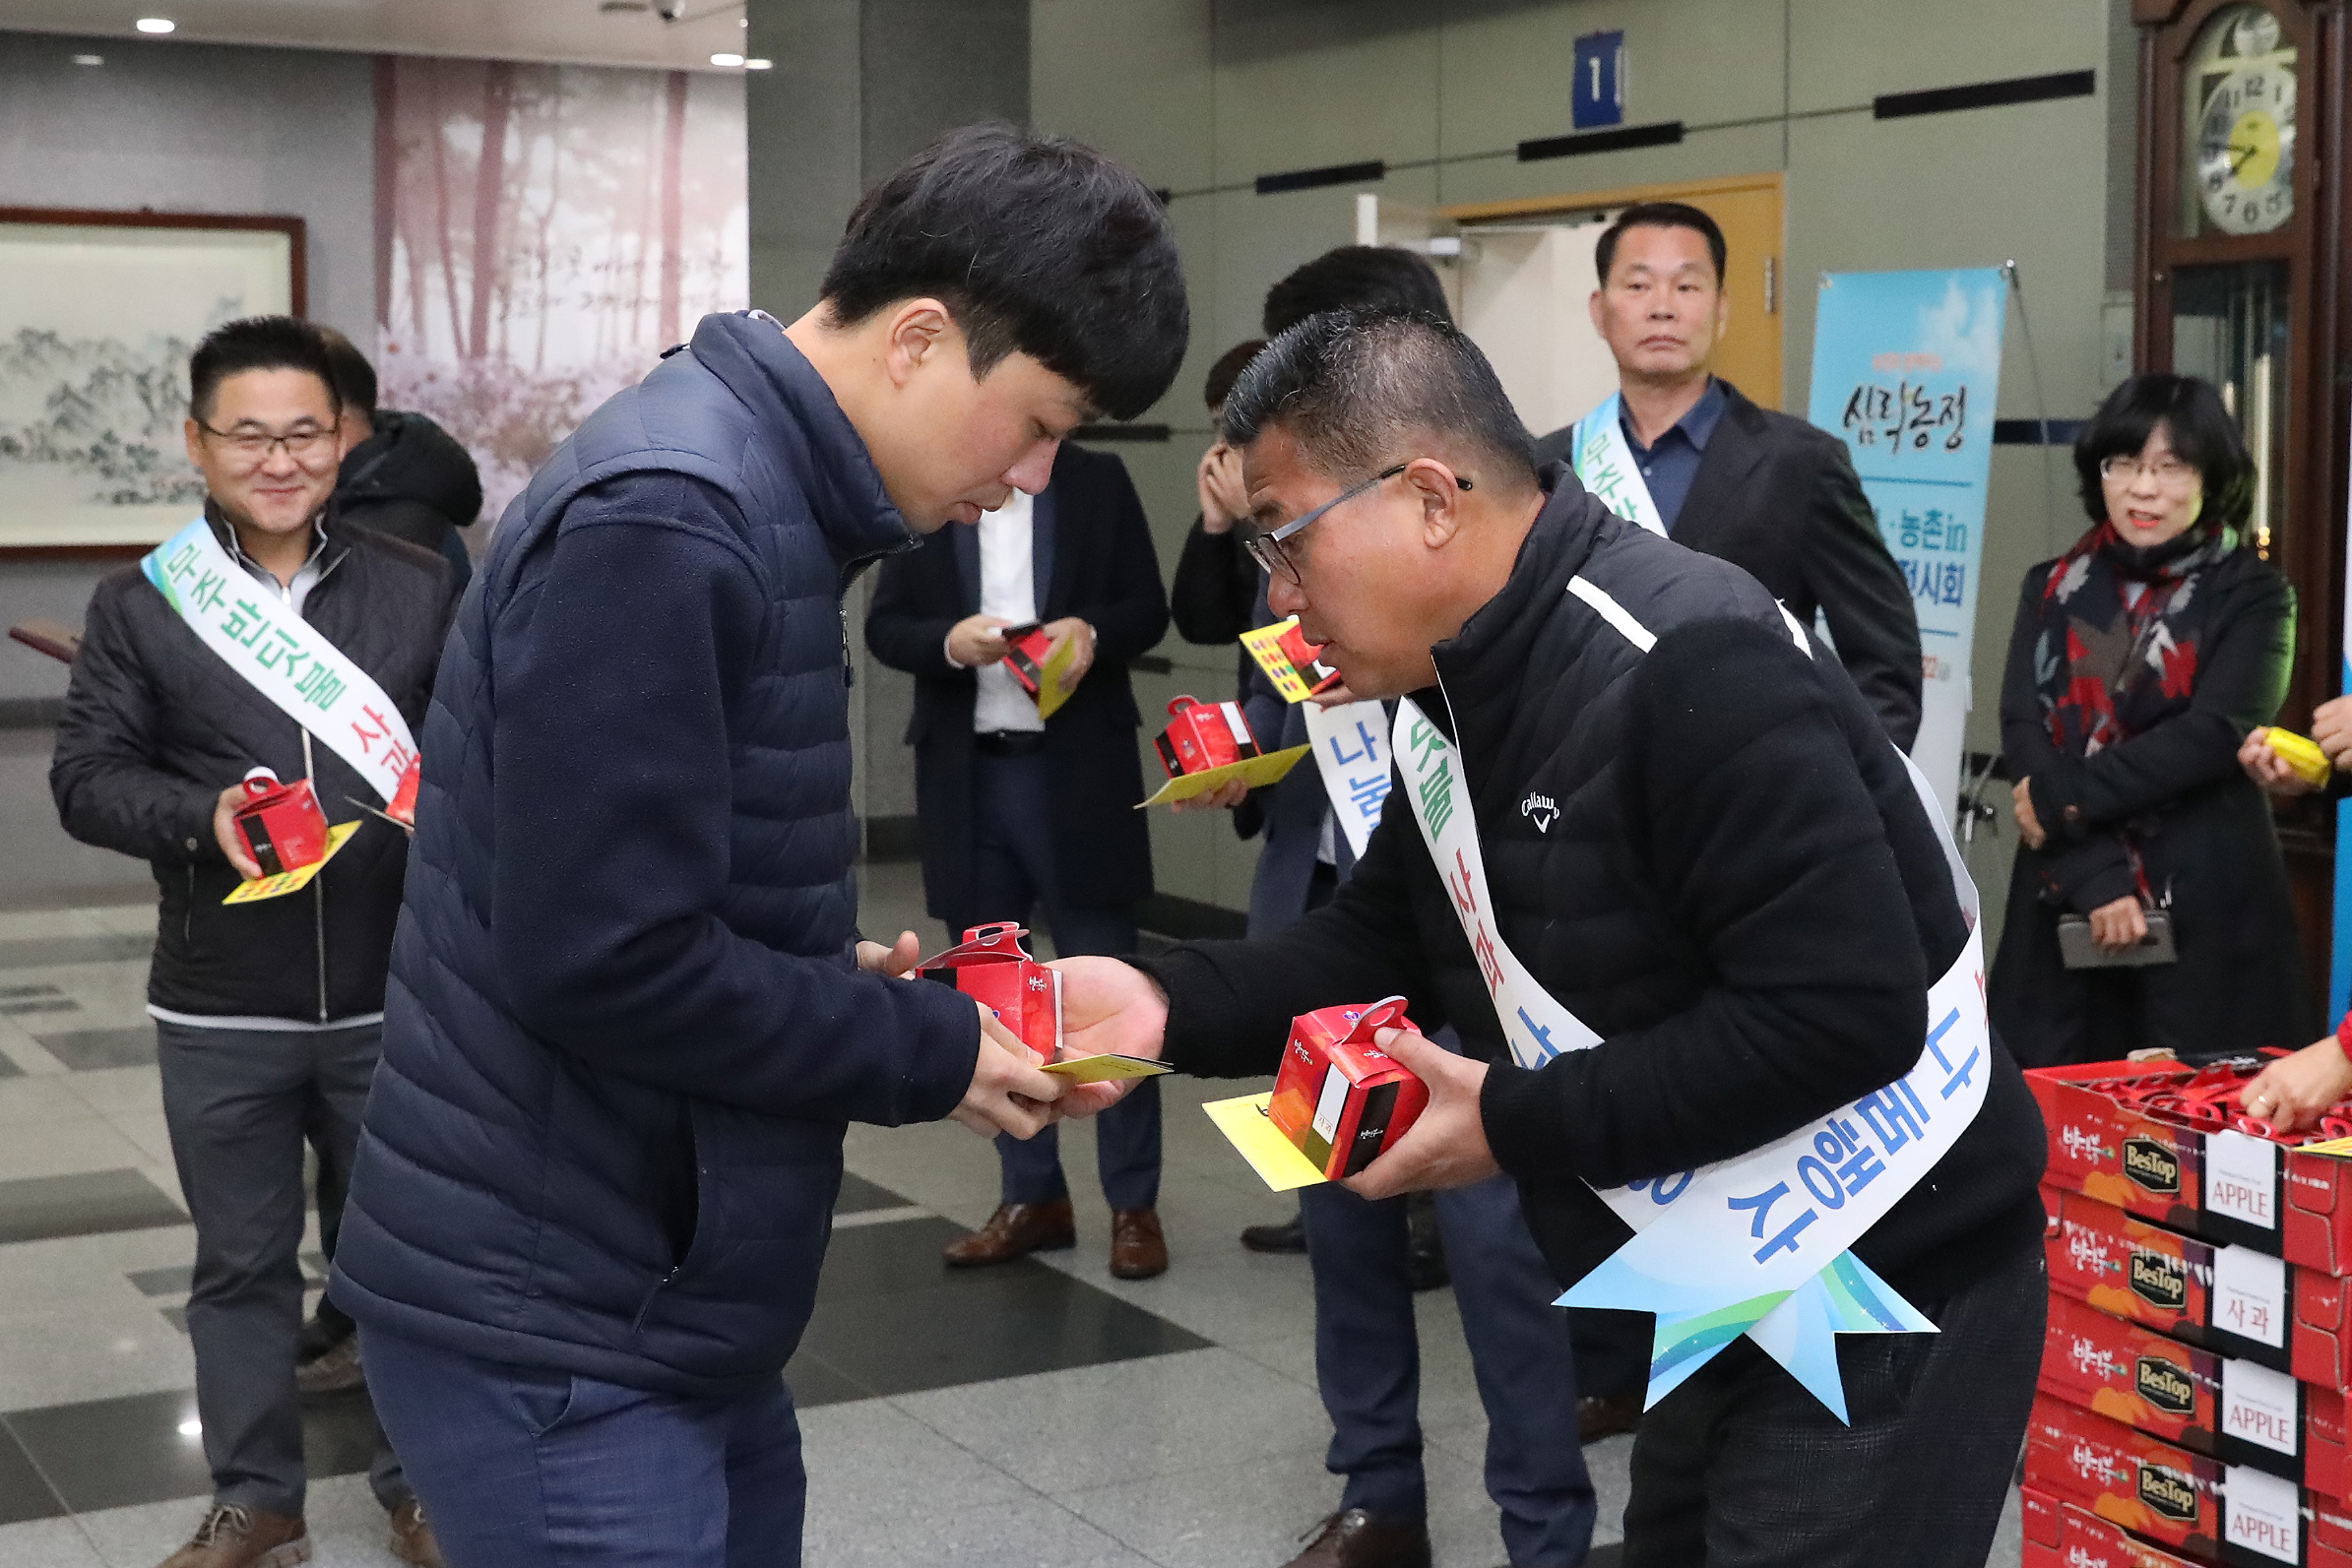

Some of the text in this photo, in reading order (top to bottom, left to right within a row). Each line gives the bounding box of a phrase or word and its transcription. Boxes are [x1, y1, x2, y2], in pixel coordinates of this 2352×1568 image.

[1588, 56, 1601, 102] 1
[165, 542, 348, 711] 무주반딧불
[2212, 1180, 2268, 1218] APPLE
[2229, 1404, 2289, 1444] APPLE
[2232, 1514, 2291, 1553] APPLE
